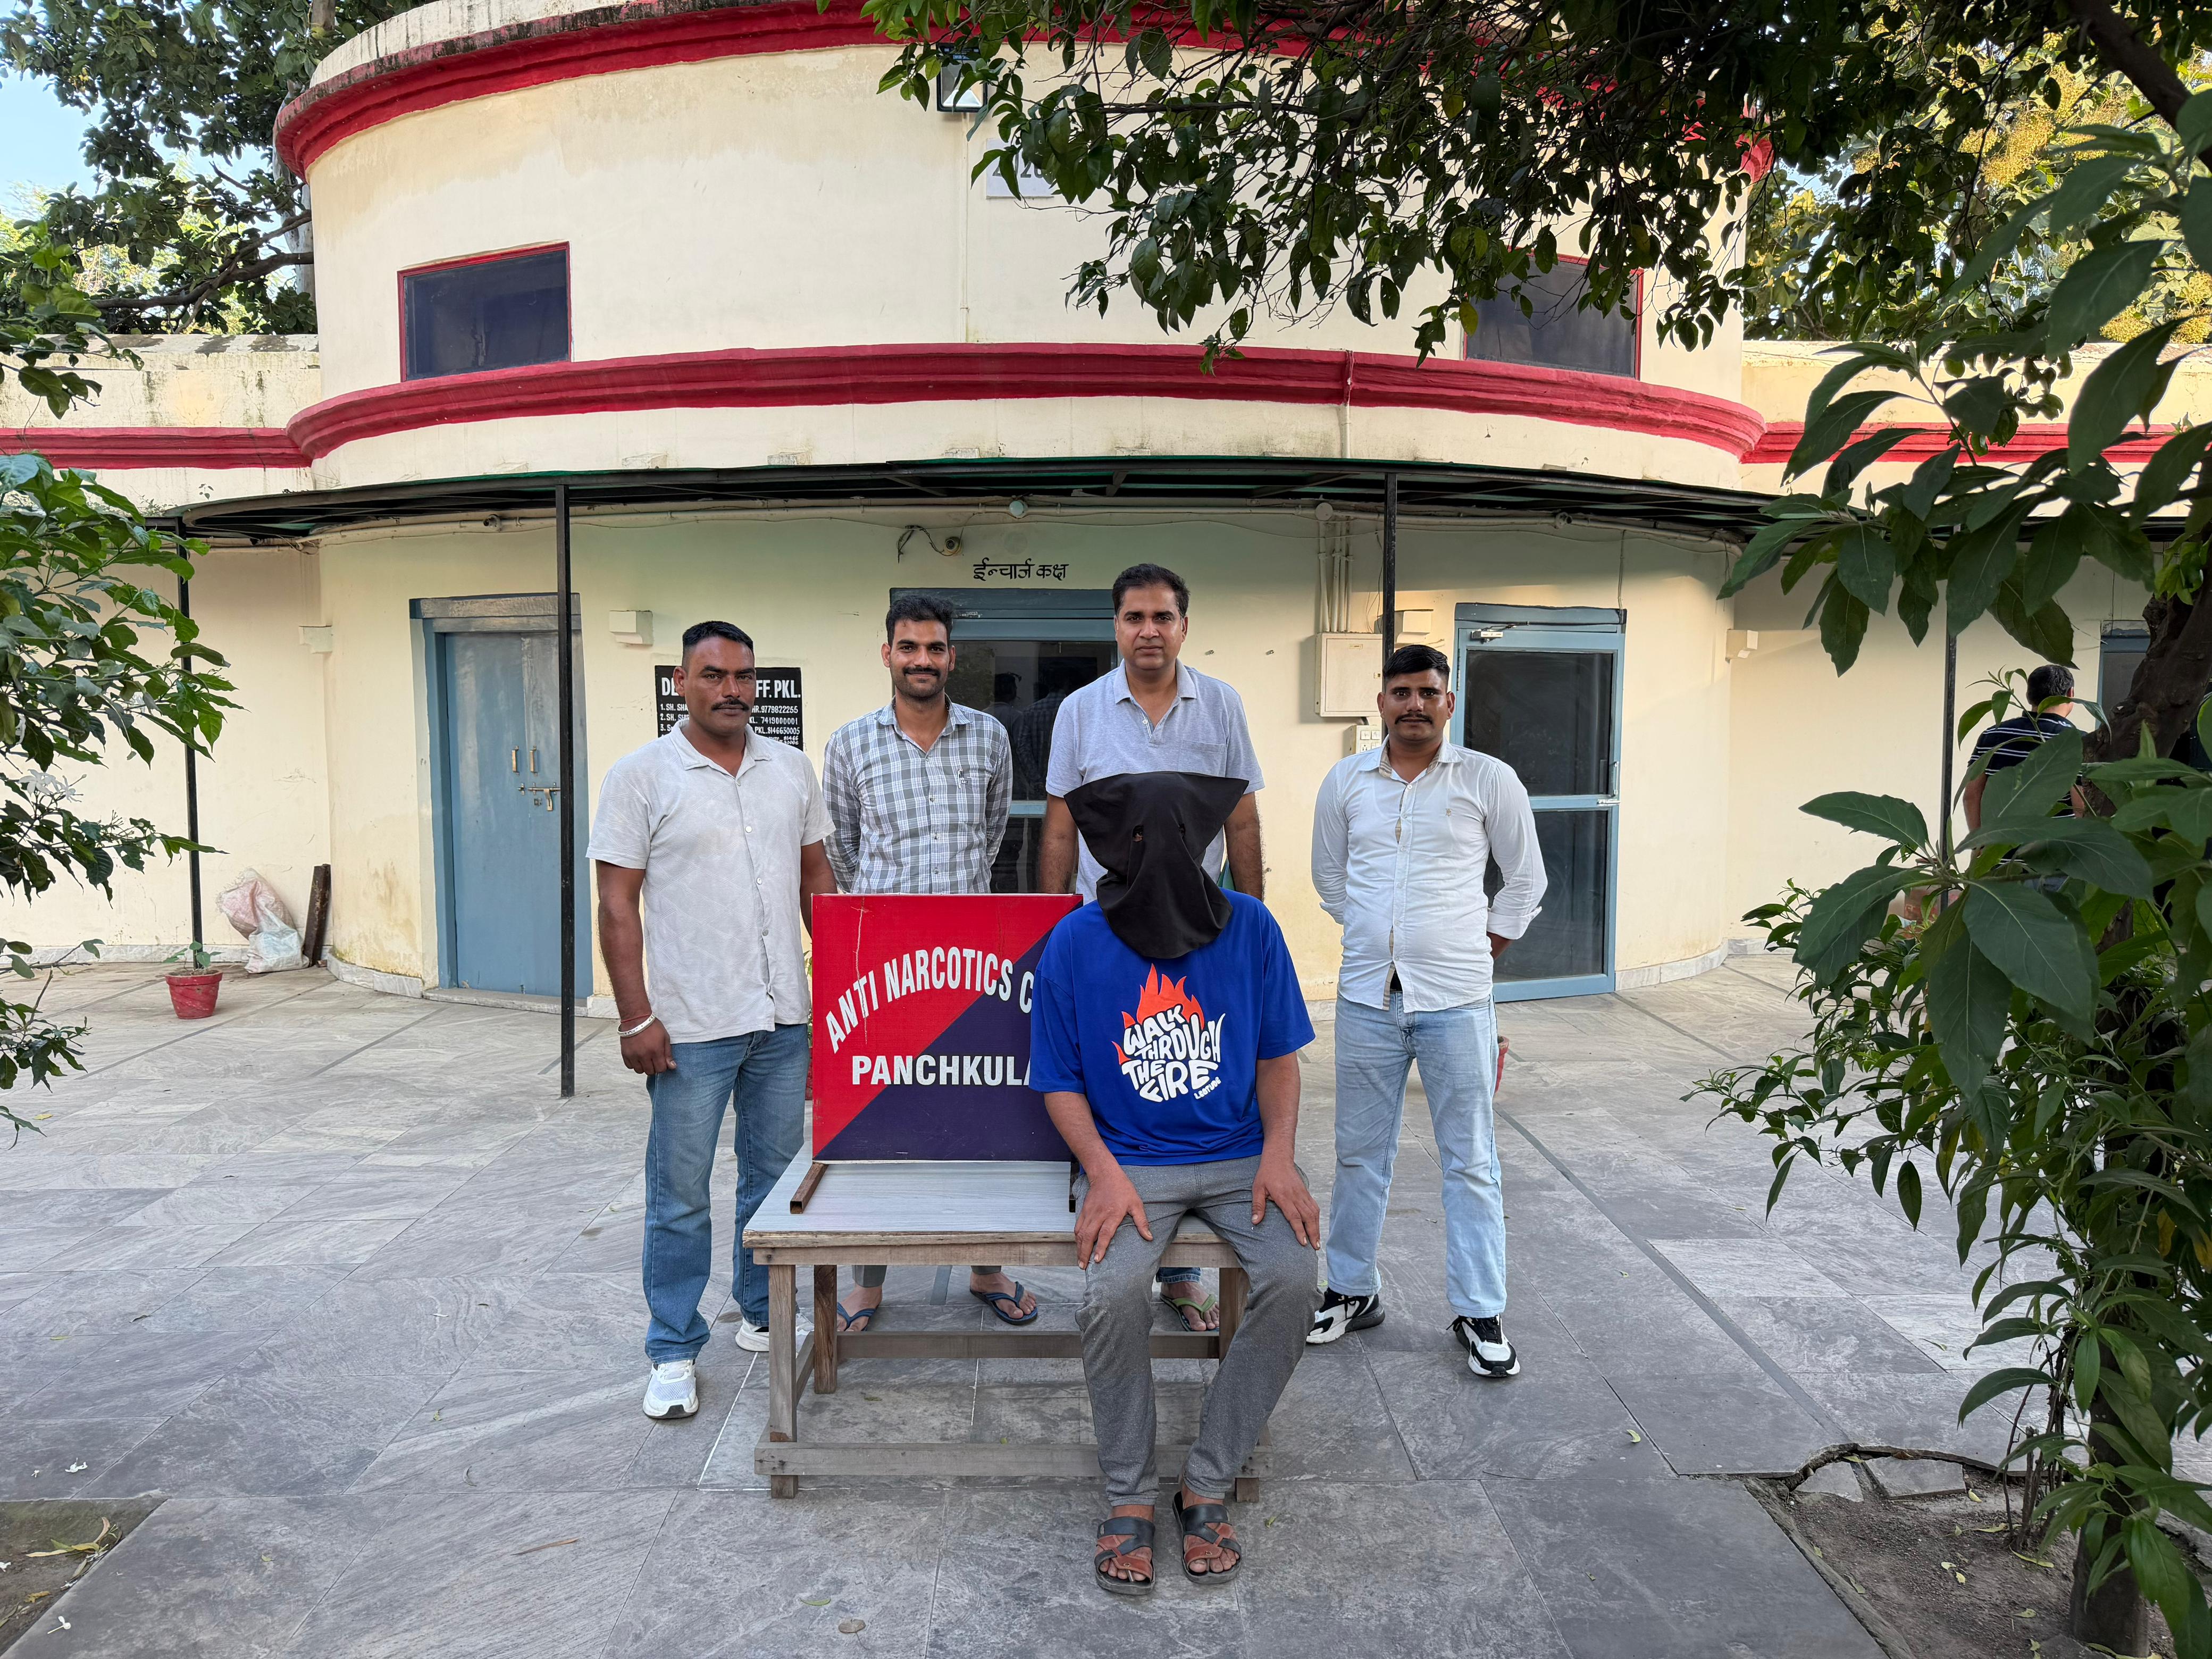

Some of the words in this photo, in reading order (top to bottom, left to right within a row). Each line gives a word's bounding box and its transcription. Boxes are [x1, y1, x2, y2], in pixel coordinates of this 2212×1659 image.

[973, 557, 1035, 581] ईन्चार्ज
[1036, 564, 1069, 581] कक्ष
[774, 680, 801, 698] PKL.
[826, 970, 879, 1054] ANTI
[884, 946, 1013, 1003] NARCOTICS
[1123, 1005, 1185, 1055] WALK
[1134, 1013, 1226, 1062] THROUGH
[1121, 1059, 1166, 1090] THE
[1139, 1059, 1219, 1102] FIRE
